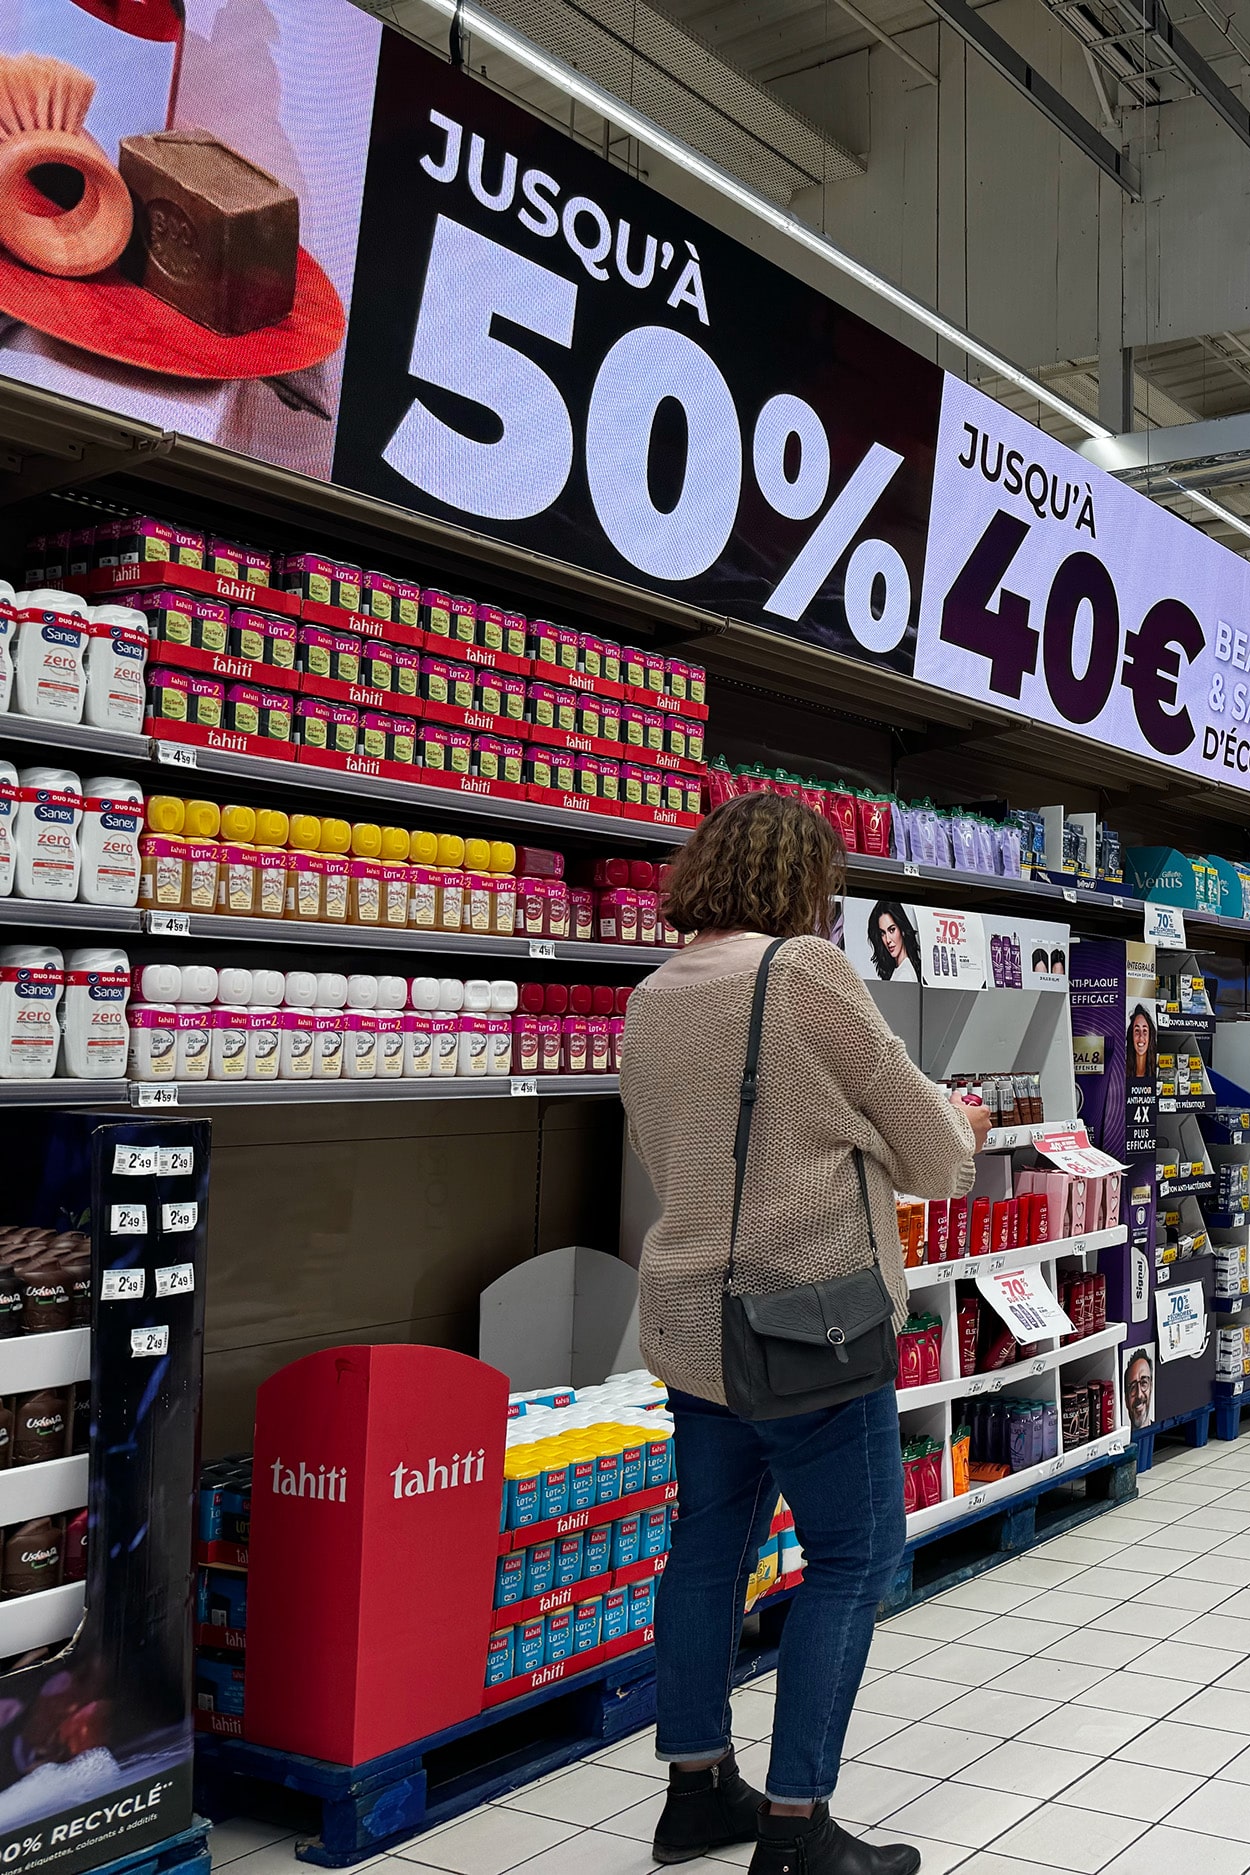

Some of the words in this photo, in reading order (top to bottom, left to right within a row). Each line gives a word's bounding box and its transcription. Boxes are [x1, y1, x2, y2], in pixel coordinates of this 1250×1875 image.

[419, 108, 711, 327] JUSQU'À
[380, 212, 911, 653] 50%
[957, 420, 1097, 539] JUSQU'À
[112, 564, 141, 583] tahiti
[216, 577, 256, 602] tahiti
[348, 615, 384, 637] tahiti
[940, 508, 1206, 756] 40€
[46, 628, 79, 645] Sanex
[116, 641, 143, 658] Sanex
[465, 647, 496, 667] tahiti
[44, 652, 77, 669] zero
[212, 655, 253, 678] tahiti
[114, 665, 141, 681] zero
[568, 674, 595, 692] tahiti
[1208, 669, 1228, 712] &
[348, 686, 384, 706] tahiti
[656, 696, 681, 712] tahiti
[463, 711, 493, 730] tahiti
[207, 729, 248, 751] tahiti
[566, 734, 592, 751] tahiti
[345, 756, 380, 775] tahiti
[655, 753, 680, 769] tahiti
[460, 775, 491, 795] tahiti
[563, 794, 590, 811] tahiti
[38, 805, 72, 821] Sanex
[104, 814, 135, 829] Sanex
[653, 809, 677, 824] tahiti
[37, 831, 71, 846] zero
[103, 838, 133, 854] zero
[1134, 871, 1183, 890] Venus
[20, 983, 53, 997] Sanex
[94, 985, 123, 998] Sanex
[1069, 977, 1119, 988] NTI-PLAQUE
[17, 1009, 51, 1023] zero
[92, 1011, 122, 1024] zero
[1131, 1086, 1152, 1095] POUVOIR
[1133, 1106, 1150, 1123] 4X
[1133, 1129, 1149, 1138] PLUS
[1126, 1139, 1156, 1150] EFFICACE
[1136, 1257, 1145, 1300] Signal
[270, 1456, 348, 1503] tahiti
[390, 1447, 485, 1500] tahiti
[557, 1511, 589, 1533] tahiti
[539, 1588, 572, 1611] tahiti
[531, 1662, 565, 1687] tahiti
[211, 1715, 242, 1735] tahiti
[75, 1830, 117, 1851] colorants
[118, 1826, 124, 1835] &
[126, 1812, 158, 1831] additifs
[0, 1832, 43, 1864] 0%
